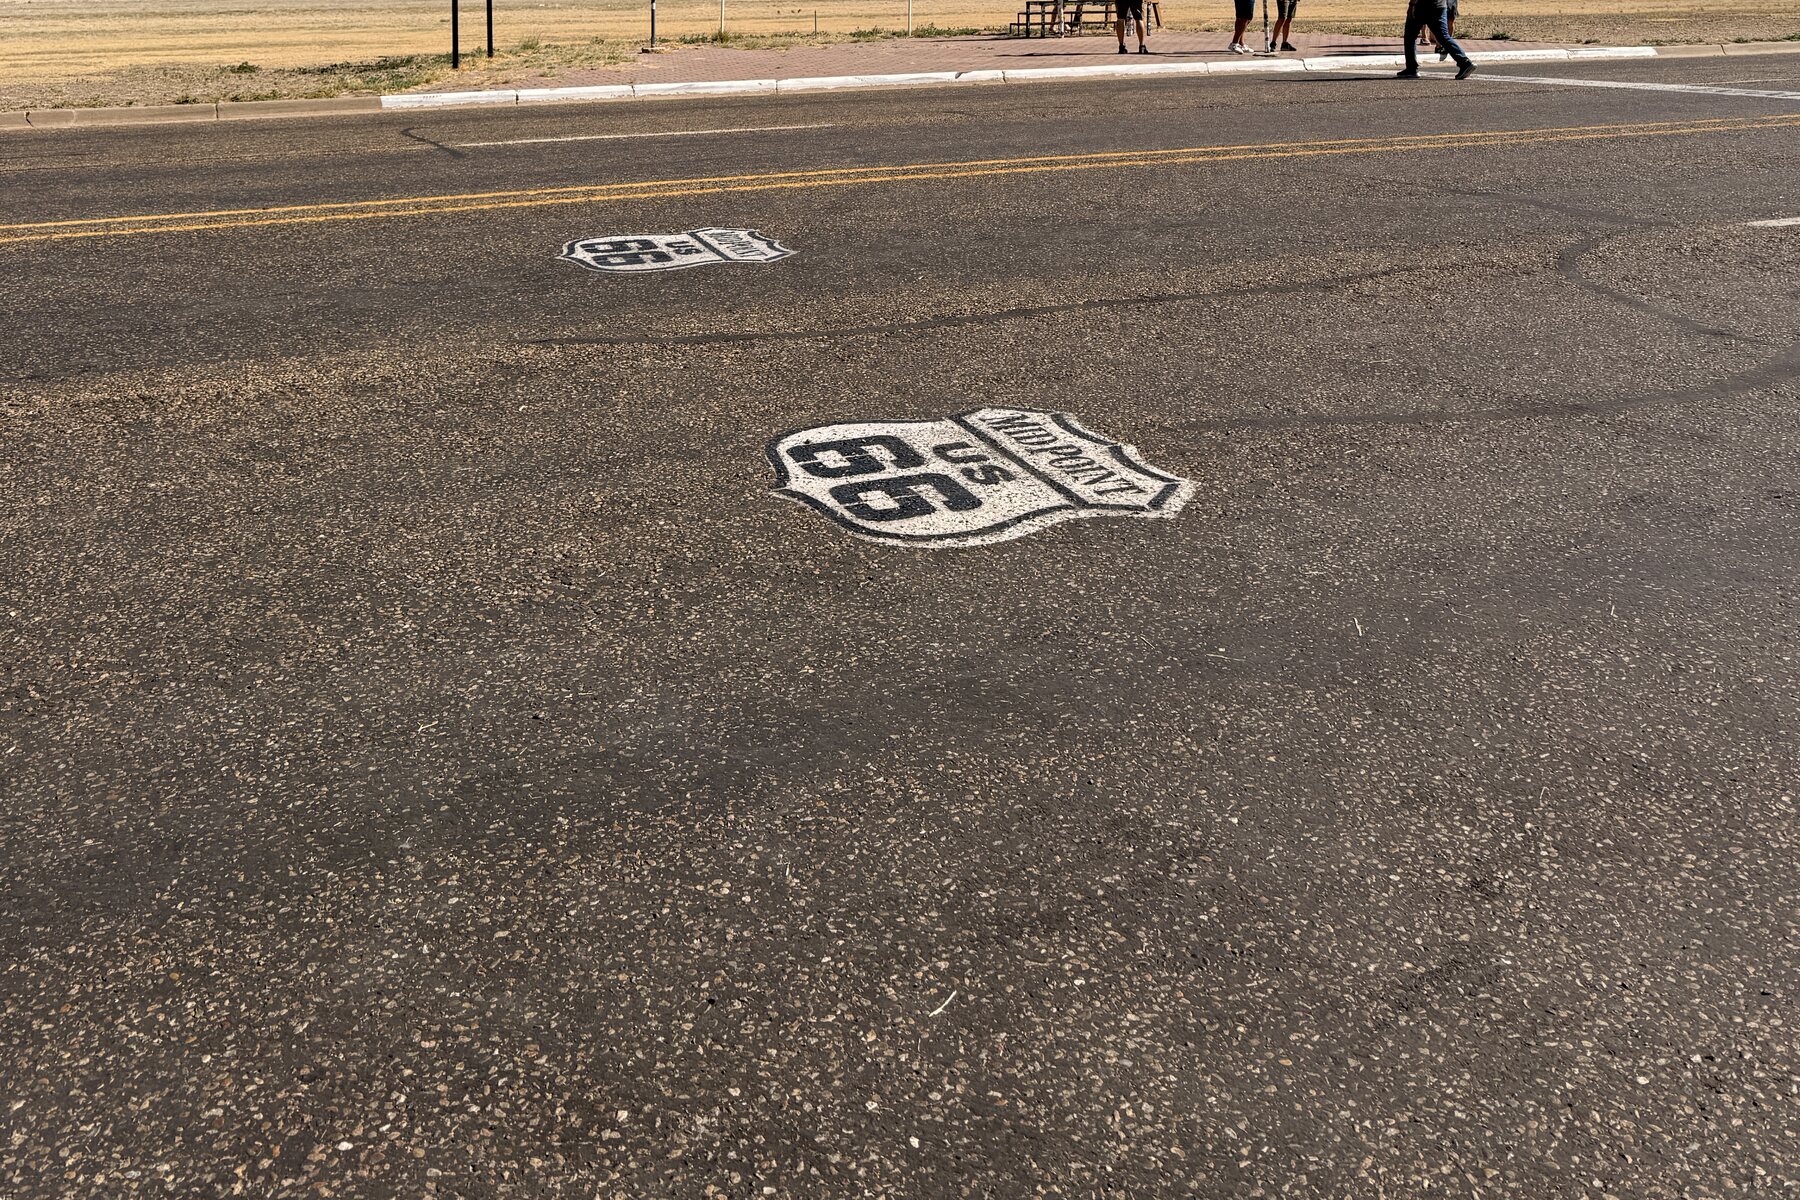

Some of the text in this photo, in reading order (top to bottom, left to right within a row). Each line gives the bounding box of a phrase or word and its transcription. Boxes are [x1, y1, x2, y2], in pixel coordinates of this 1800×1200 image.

[580, 239, 674, 267] 66
[664, 240, 703, 256] US
[931, 441, 1017, 486] US
[978, 413, 1147, 496] MIDPOINT
[786, 434, 983, 522] 66
